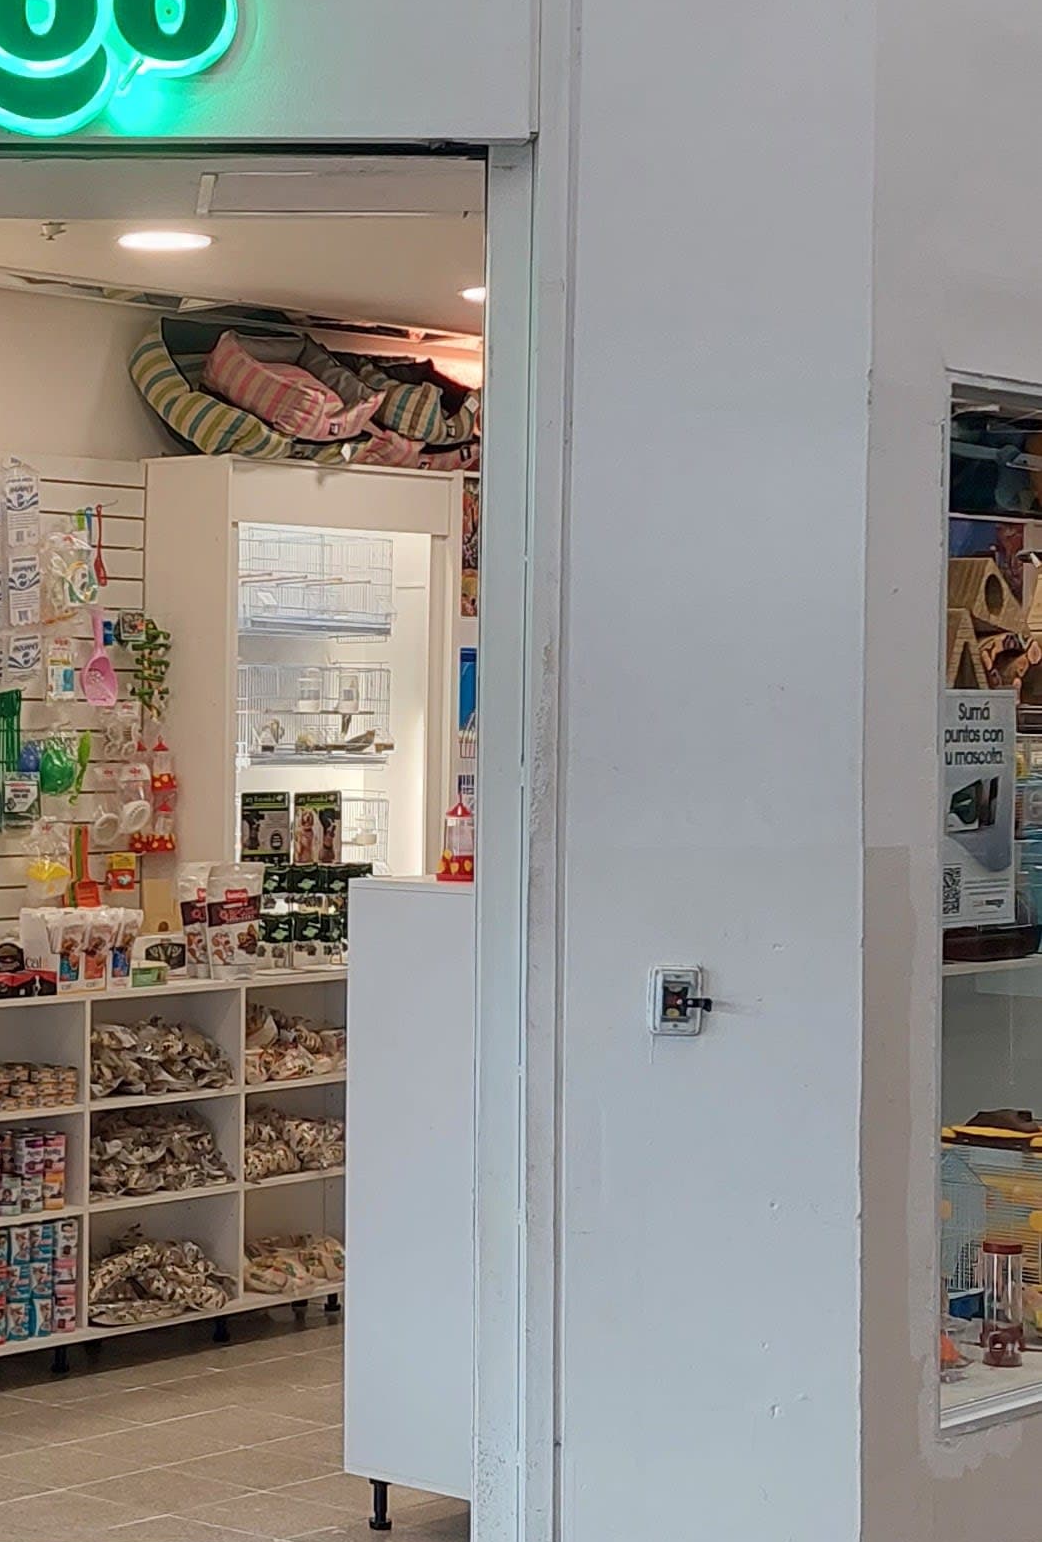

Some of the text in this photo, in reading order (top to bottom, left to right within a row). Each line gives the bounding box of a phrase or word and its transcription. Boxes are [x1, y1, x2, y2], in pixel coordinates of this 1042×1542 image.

[958, 701, 991, 721] Sumá
[944, 725, 1004, 747] puntos con
